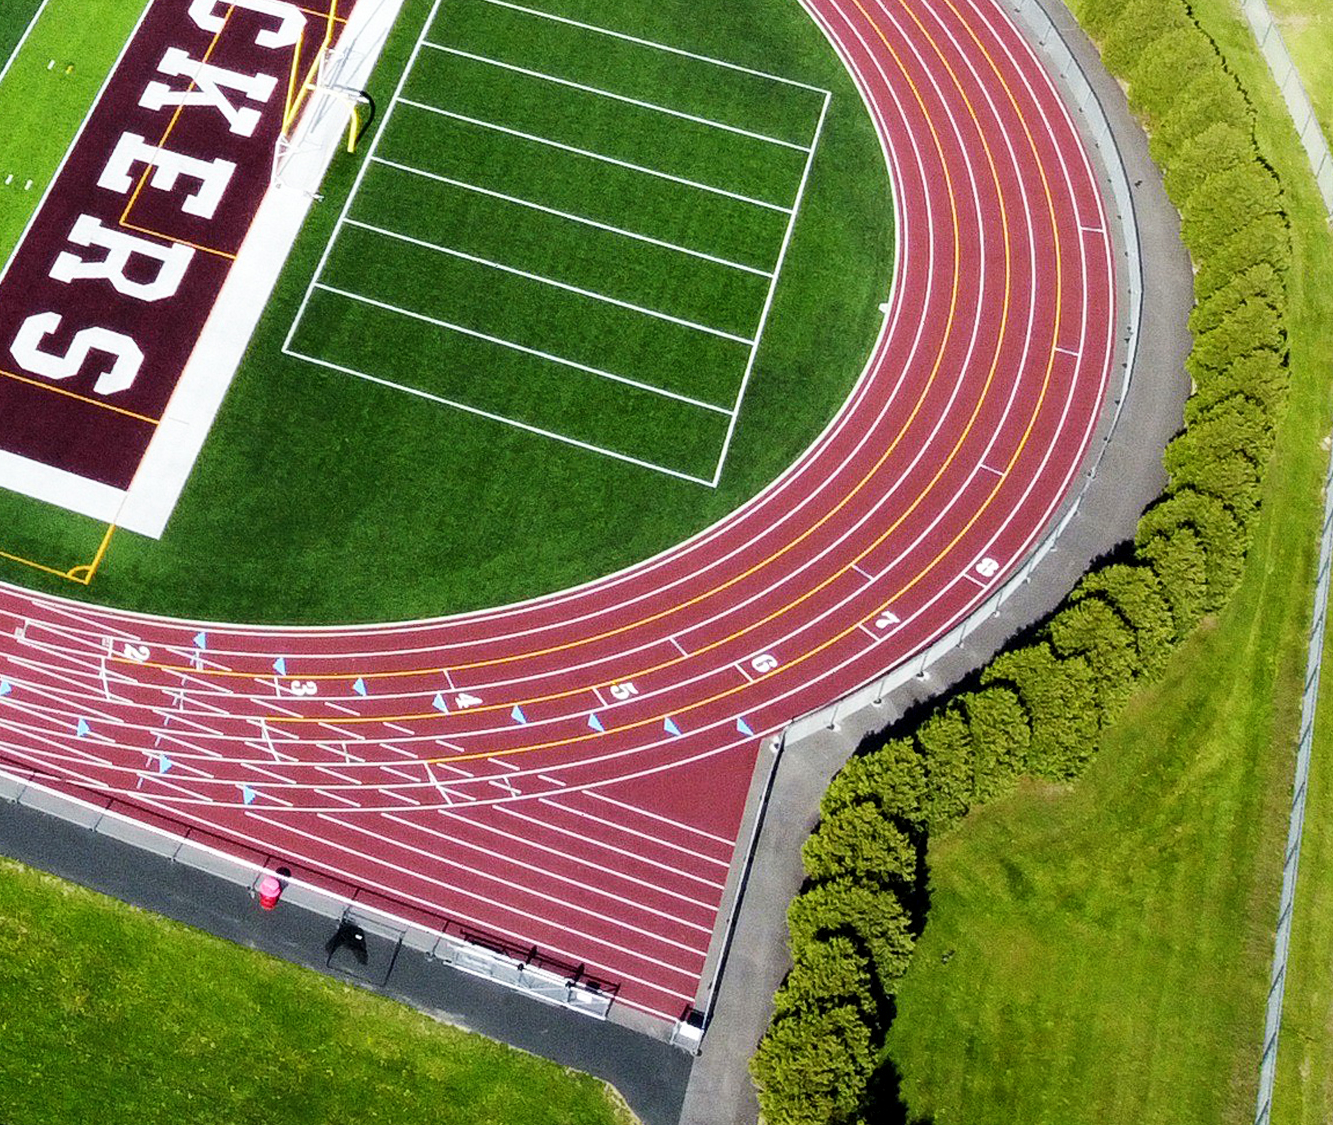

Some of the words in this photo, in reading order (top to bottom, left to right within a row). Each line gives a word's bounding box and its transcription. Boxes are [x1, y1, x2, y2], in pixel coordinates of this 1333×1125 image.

[975, 557, 1000, 578] 8
[875, 610, 901, 629] 7
[124, 644, 150, 662] 2
[751, 654, 777, 673] 6
[291, 681, 317, 695] 3
[609, 682, 640, 700] 5
[456, 693, 483, 709] 4
